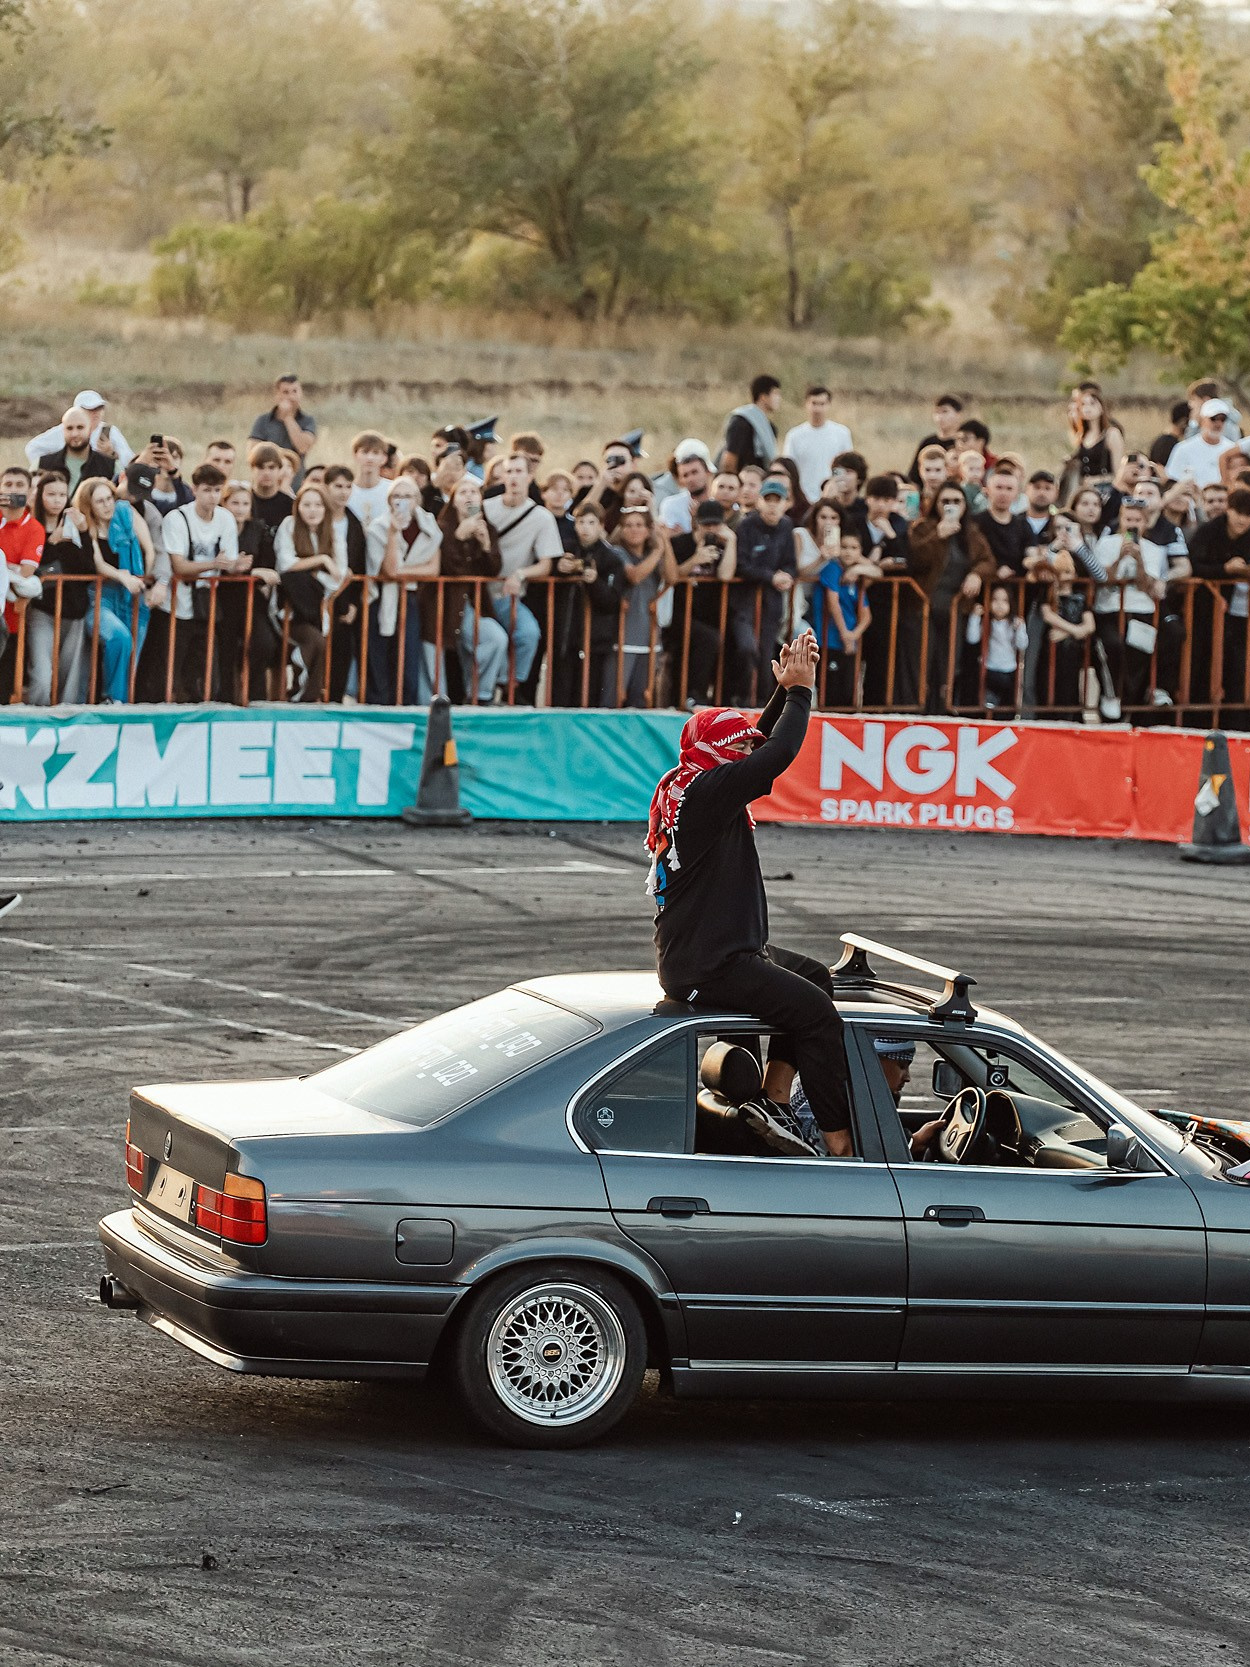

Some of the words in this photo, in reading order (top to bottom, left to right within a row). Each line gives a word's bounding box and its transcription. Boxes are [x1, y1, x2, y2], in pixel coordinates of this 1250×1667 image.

[0, 721, 416, 811] KZMEET
[820, 721, 1019, 801] NGK
[820, 798, 914, 825] SPARK
[918, 802, 1015, 830] PLUGS
